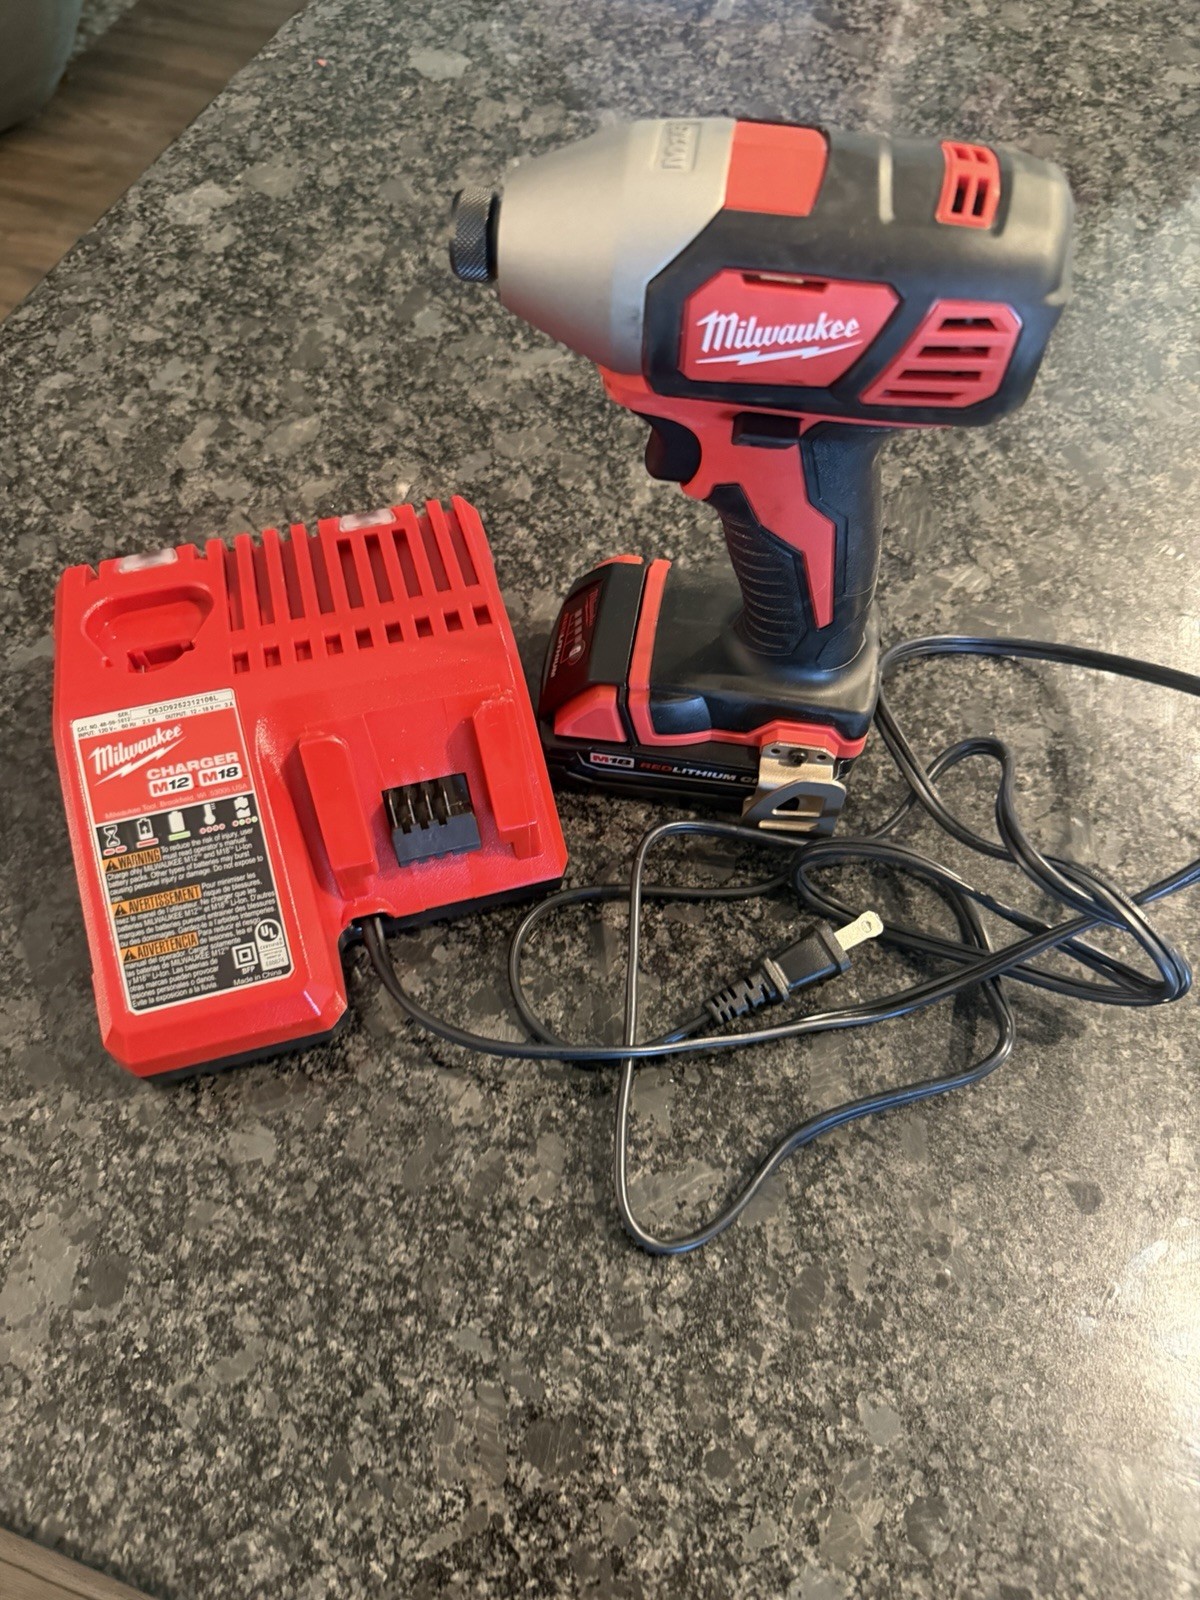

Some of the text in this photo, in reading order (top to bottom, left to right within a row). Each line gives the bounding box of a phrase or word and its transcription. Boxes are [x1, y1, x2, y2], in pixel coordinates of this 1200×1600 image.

[696, 310, 861, 353] Milwaukee
[88, 725, 183, 775] Milwaukee
[592, 754, 632, 767] M18
[146, 752, 239, 780] CHARGER
[639, 761, 737, 781] REDLITHIUM
[152, 766, 239, 795] M12 M18
[117, 848, 160, 869] WARNING
[127, 885, 200, 913] AVERTISSEMENT
[260, 924, 277, 940] UL
[136, 933, 198, 958] ADVERTENCIA
[232, 967, 283, 986] Made in China
